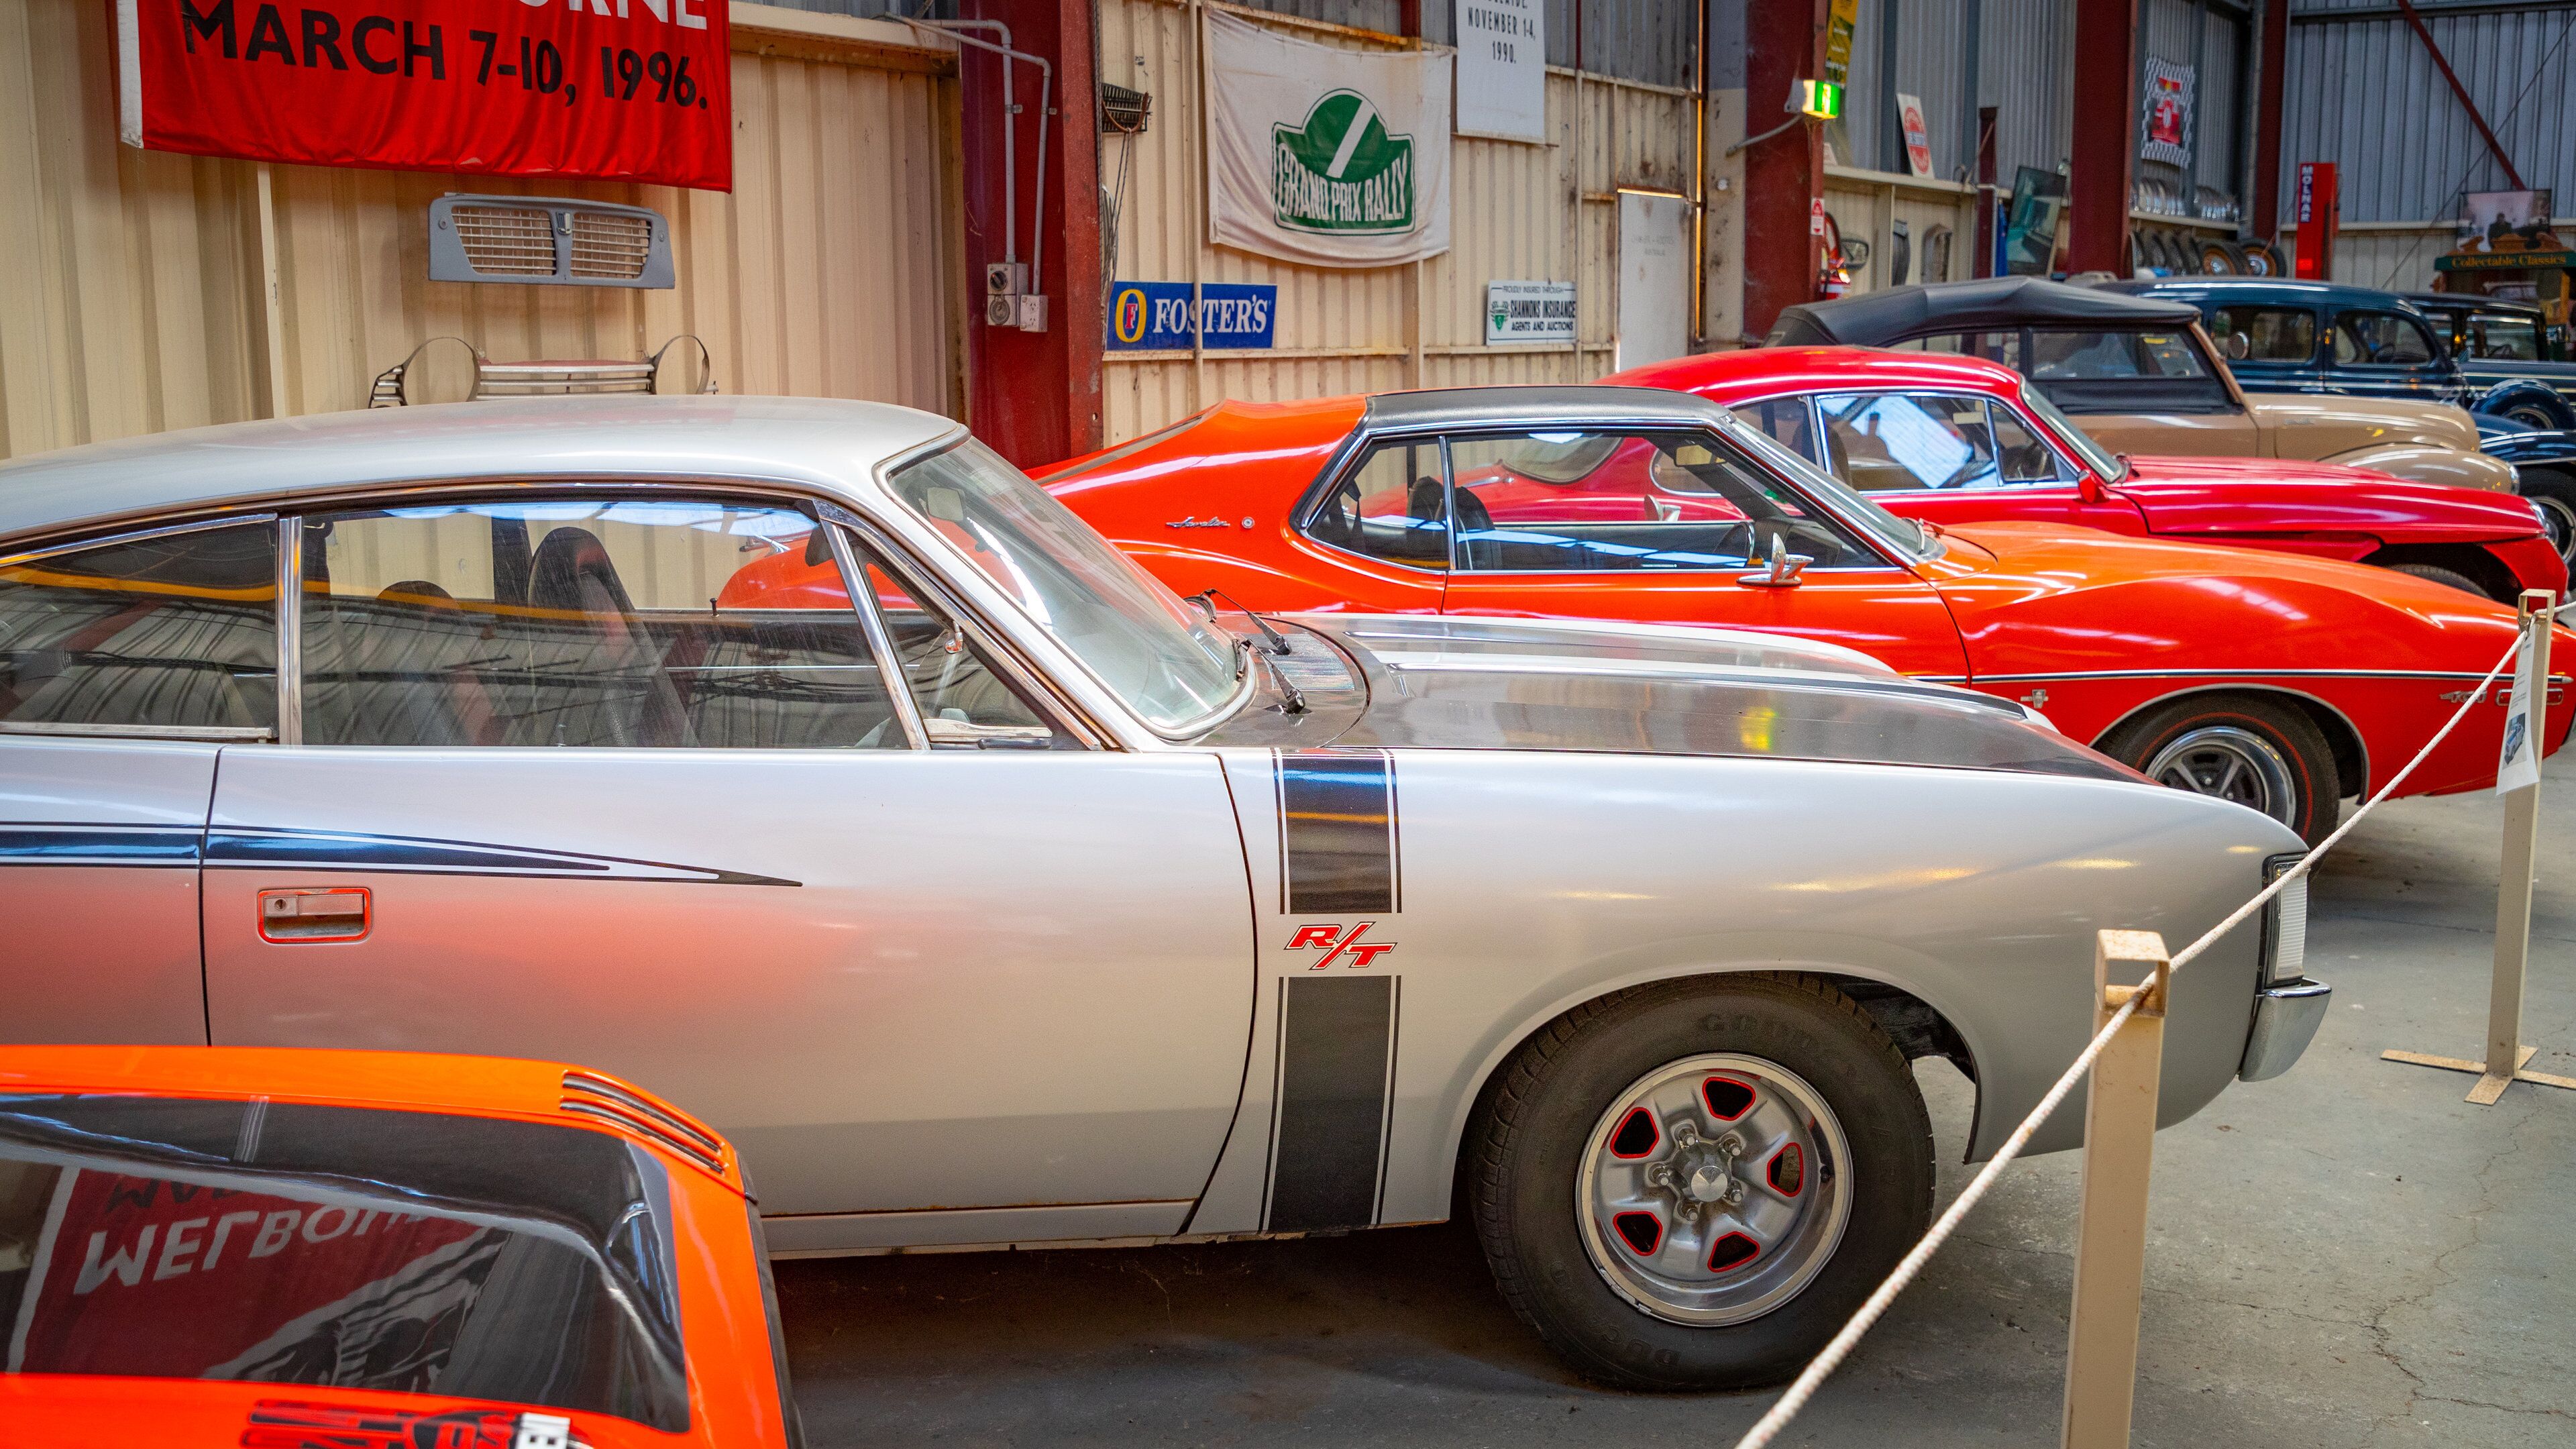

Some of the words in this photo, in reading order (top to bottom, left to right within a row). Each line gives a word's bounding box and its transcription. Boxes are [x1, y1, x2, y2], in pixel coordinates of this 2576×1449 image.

[1468, 7, 1517, 35] NOVEMBER
[179, 0, 446, 80] MARCH
[470, 30, 577, 107] 7-10,
[601, 46, 708, 110] 1996.
[1493, 40, 1516, 64] 1990.
[1277, 143, 1330, 221] GRAND
[1331, 181, 1362, 221] PRIX
[1364, 148, 1408, 221] RALLY
[2300, 165, 2314, 223] MOLNAR
[1511, 299, 1541, 319] SHANNONS
[1542, 300, 1576, 319] INSURANCE
[1511, 321, 1531, 331] AGENTS
[1533, 321, 1545, 331] AND
[1547, 321, 1574, 331] AUCTIONS
[1283, 921, 1398, 971] R/T
